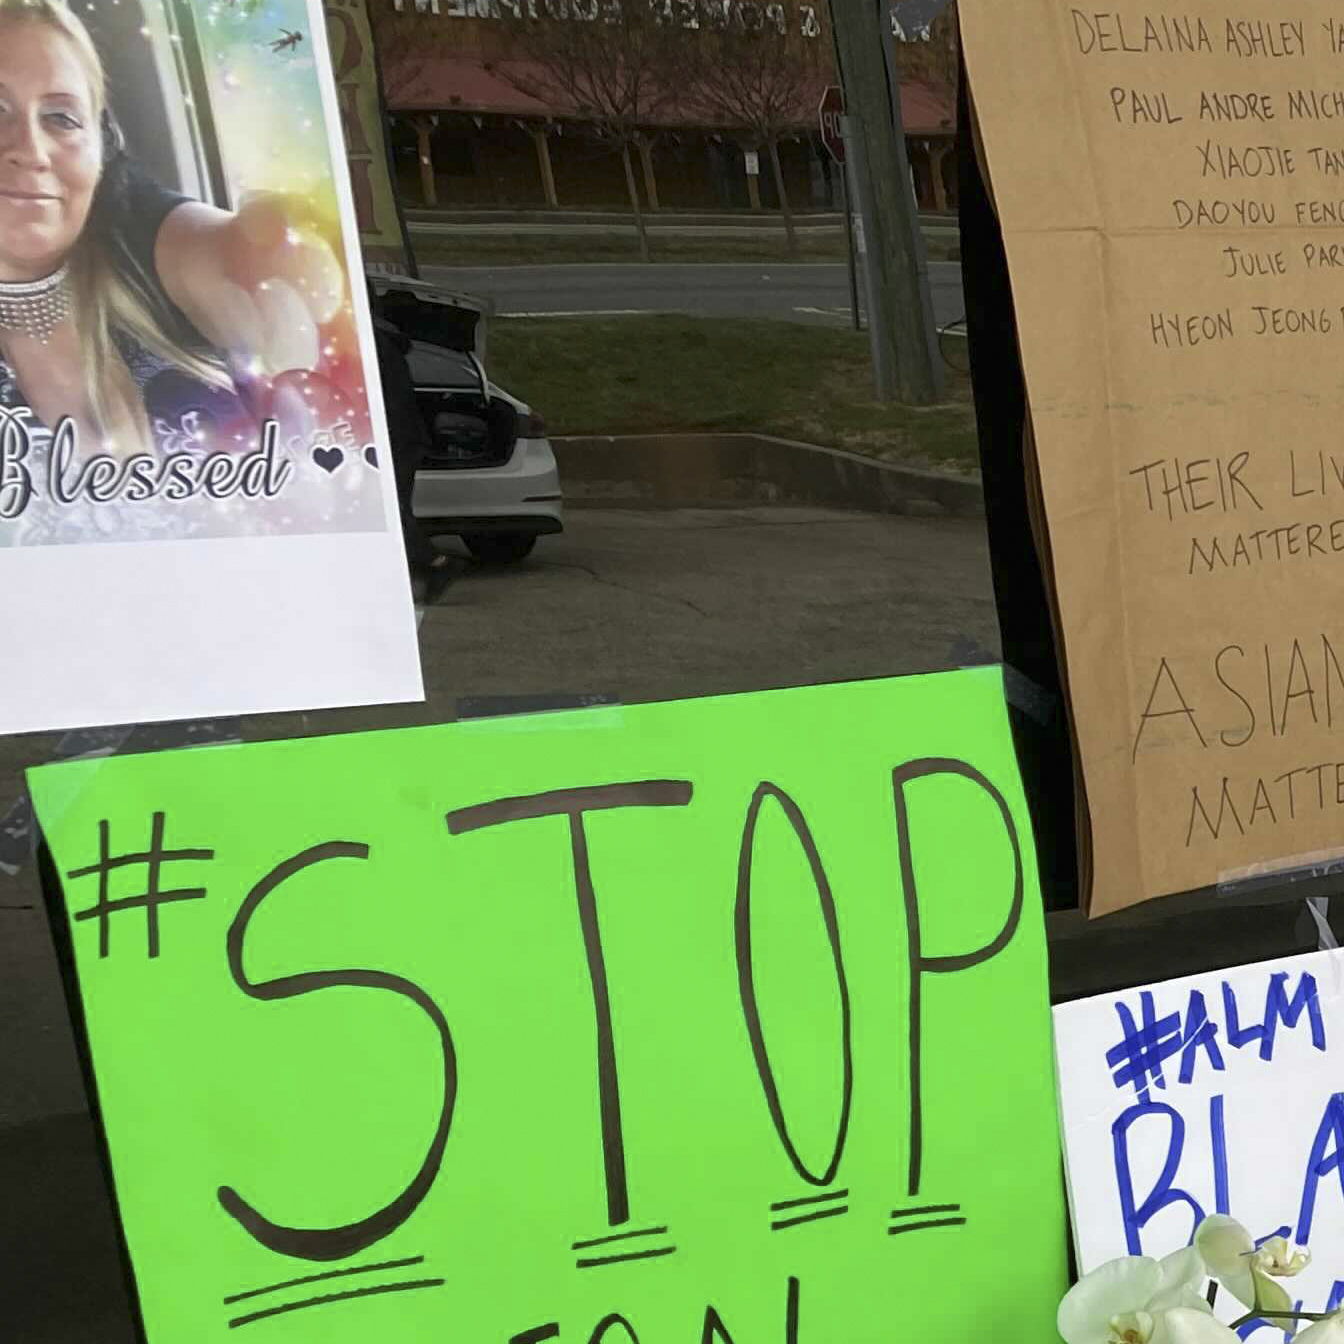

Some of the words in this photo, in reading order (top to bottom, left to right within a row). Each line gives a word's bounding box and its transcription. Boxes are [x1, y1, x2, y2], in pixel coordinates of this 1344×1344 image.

[1071, 9, 1212, 55] DELAINA
[1224, 18, 1306, 57] ASHLEY
[1110, 86, 1183, 124] PAUL
[1199, 91, 1276, 122] ANDRE
[1196, 139, 1297, 179] XIAOJIE
[1172, 200, 1276, 230] DAOYOU
[1223, 246, 1287, 278] JULIE
[1150, 312, 1235, 349] HYEON
[1251, 306, 1332, 336] JEONG
[0, 405, 293, 521] Blessed
[1129, 451, 1264, 522] THEIR
